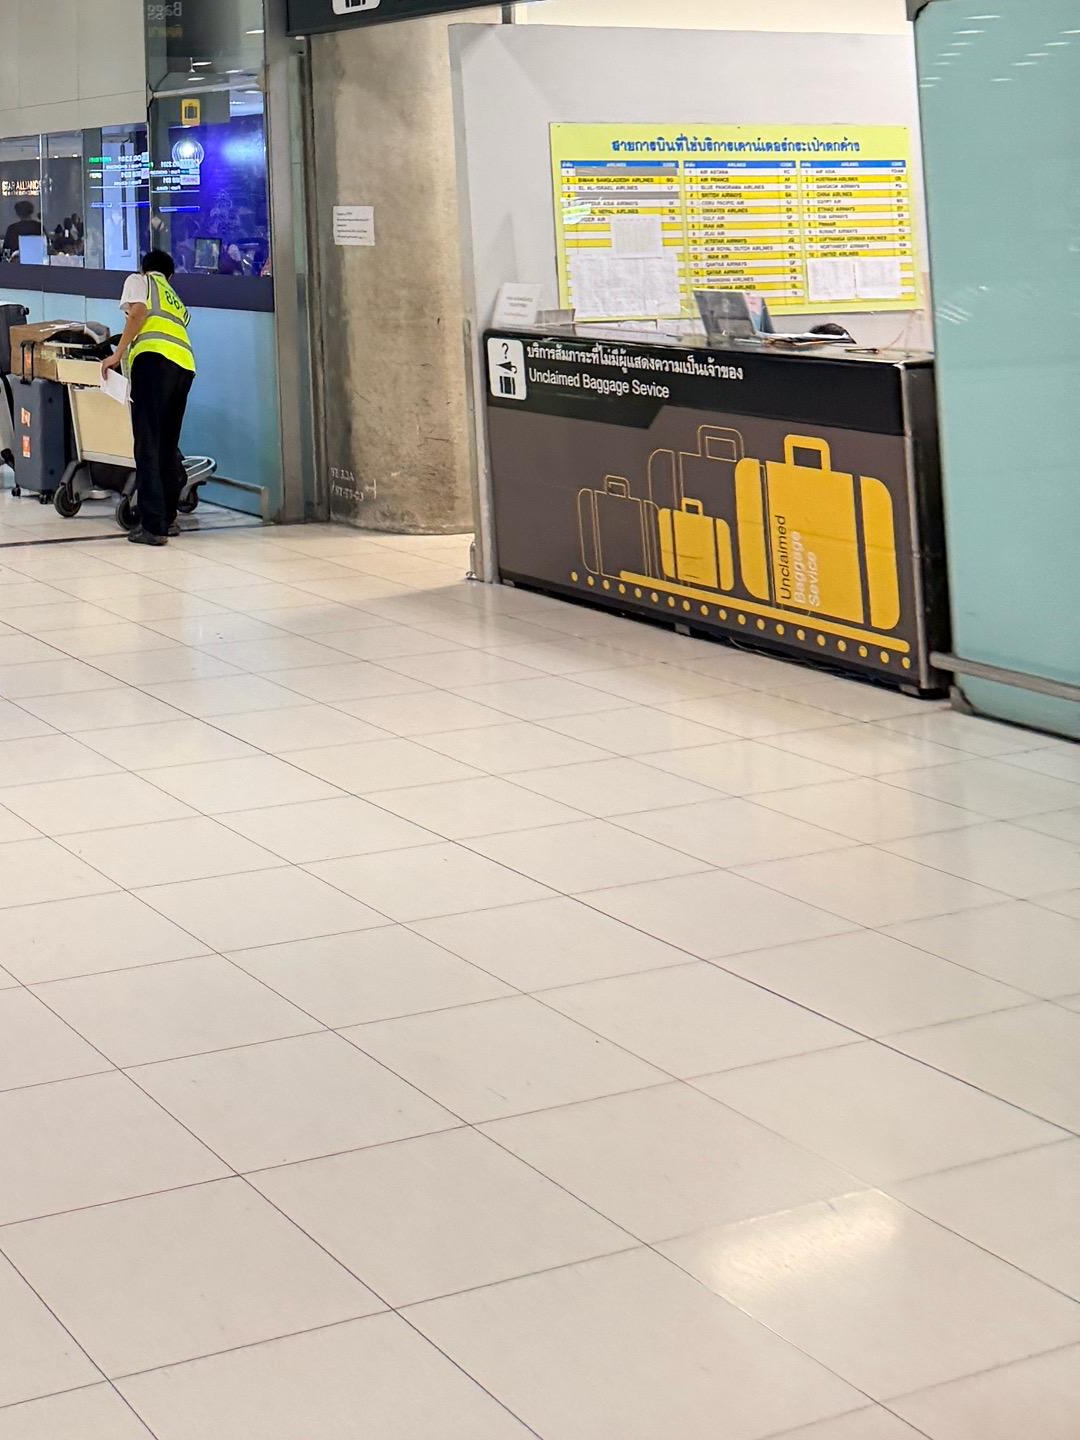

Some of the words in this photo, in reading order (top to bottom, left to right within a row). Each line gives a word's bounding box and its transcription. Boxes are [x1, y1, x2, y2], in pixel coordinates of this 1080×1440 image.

[528, 367, 580, 388] Unclaimed
[582, 371, 629, 396] Baggage
[632, 379, 669, 399] Sevice
[775, 515, 791, 600] Unclaimed
